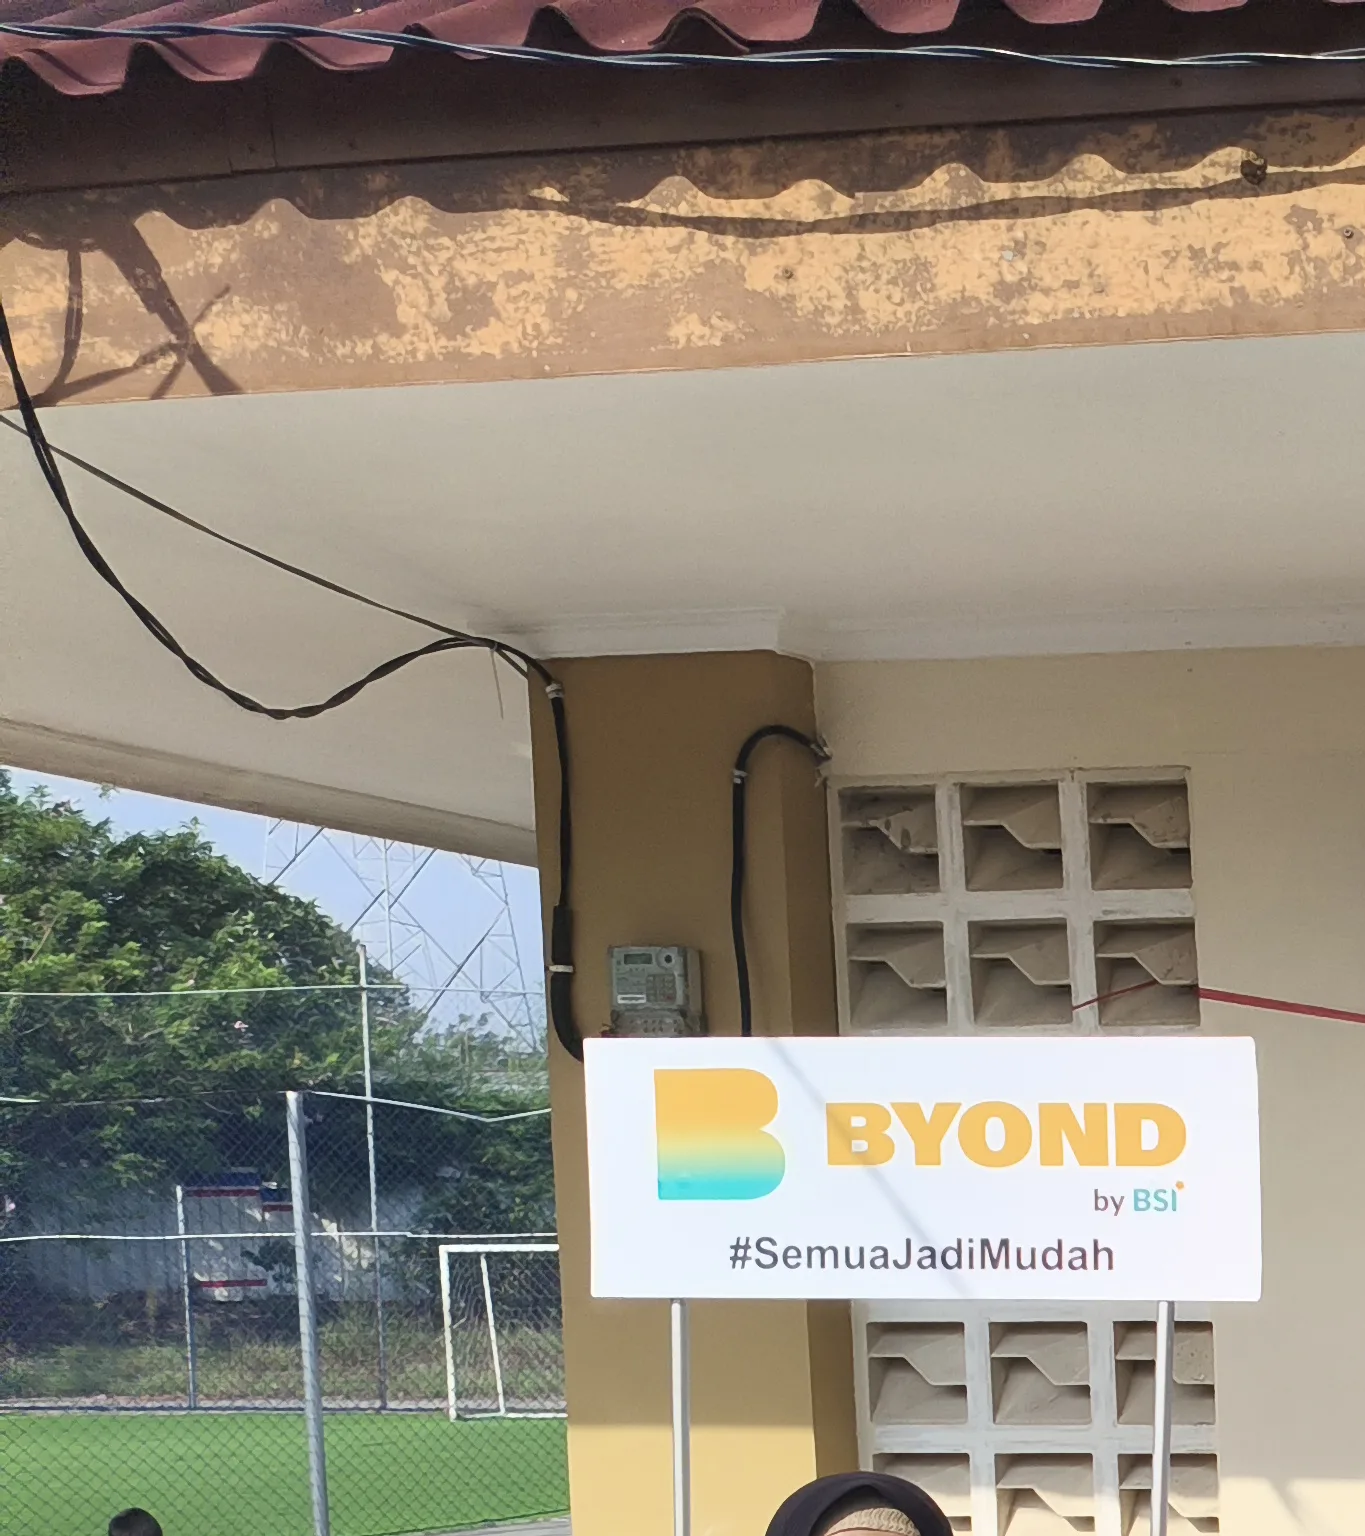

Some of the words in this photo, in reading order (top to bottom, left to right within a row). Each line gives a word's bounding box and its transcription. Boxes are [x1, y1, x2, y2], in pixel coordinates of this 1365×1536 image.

[825, 1101, 1187, 1167] BYOND
[1093, 1188, 1125, 1216] by
[1132, 1184, 1180, 1212] BSI
[729, 1236, 1115, 1272] #SemuaJadiMudah
